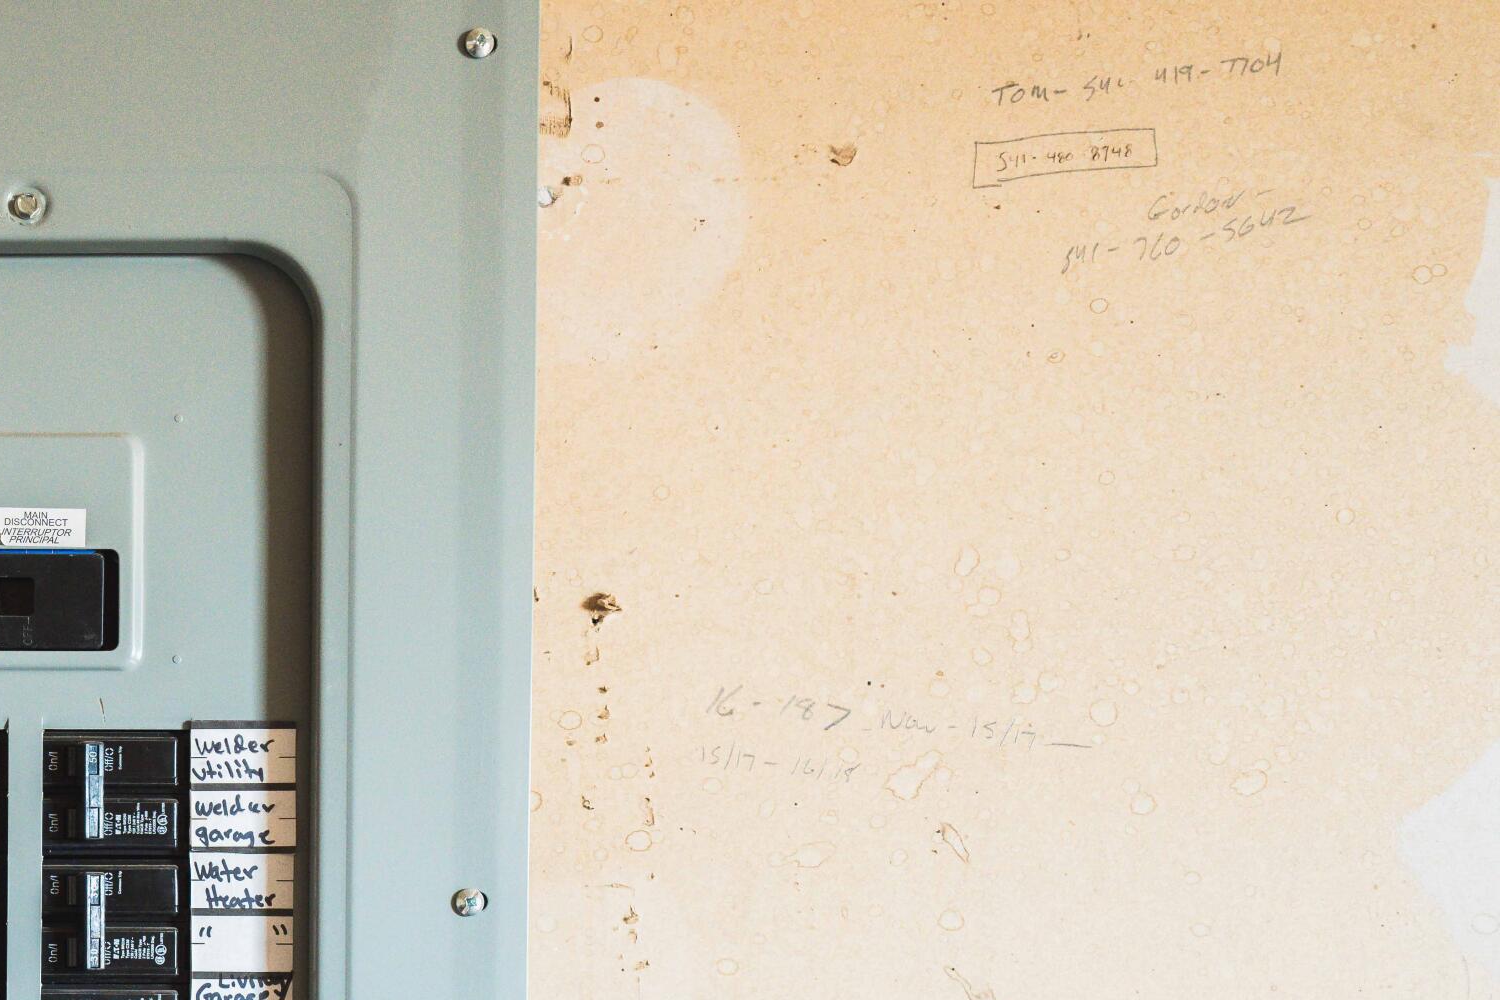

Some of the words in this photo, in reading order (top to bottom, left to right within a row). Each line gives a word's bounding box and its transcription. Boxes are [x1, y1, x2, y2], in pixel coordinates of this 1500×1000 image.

[4, 518, 68, 526] DISCONNECT
[2, 528, 72, 536] INTERRUPTOR
[9, 536, 60, 544] PRINCIPAL
[194, 859, 259, 882] Water
